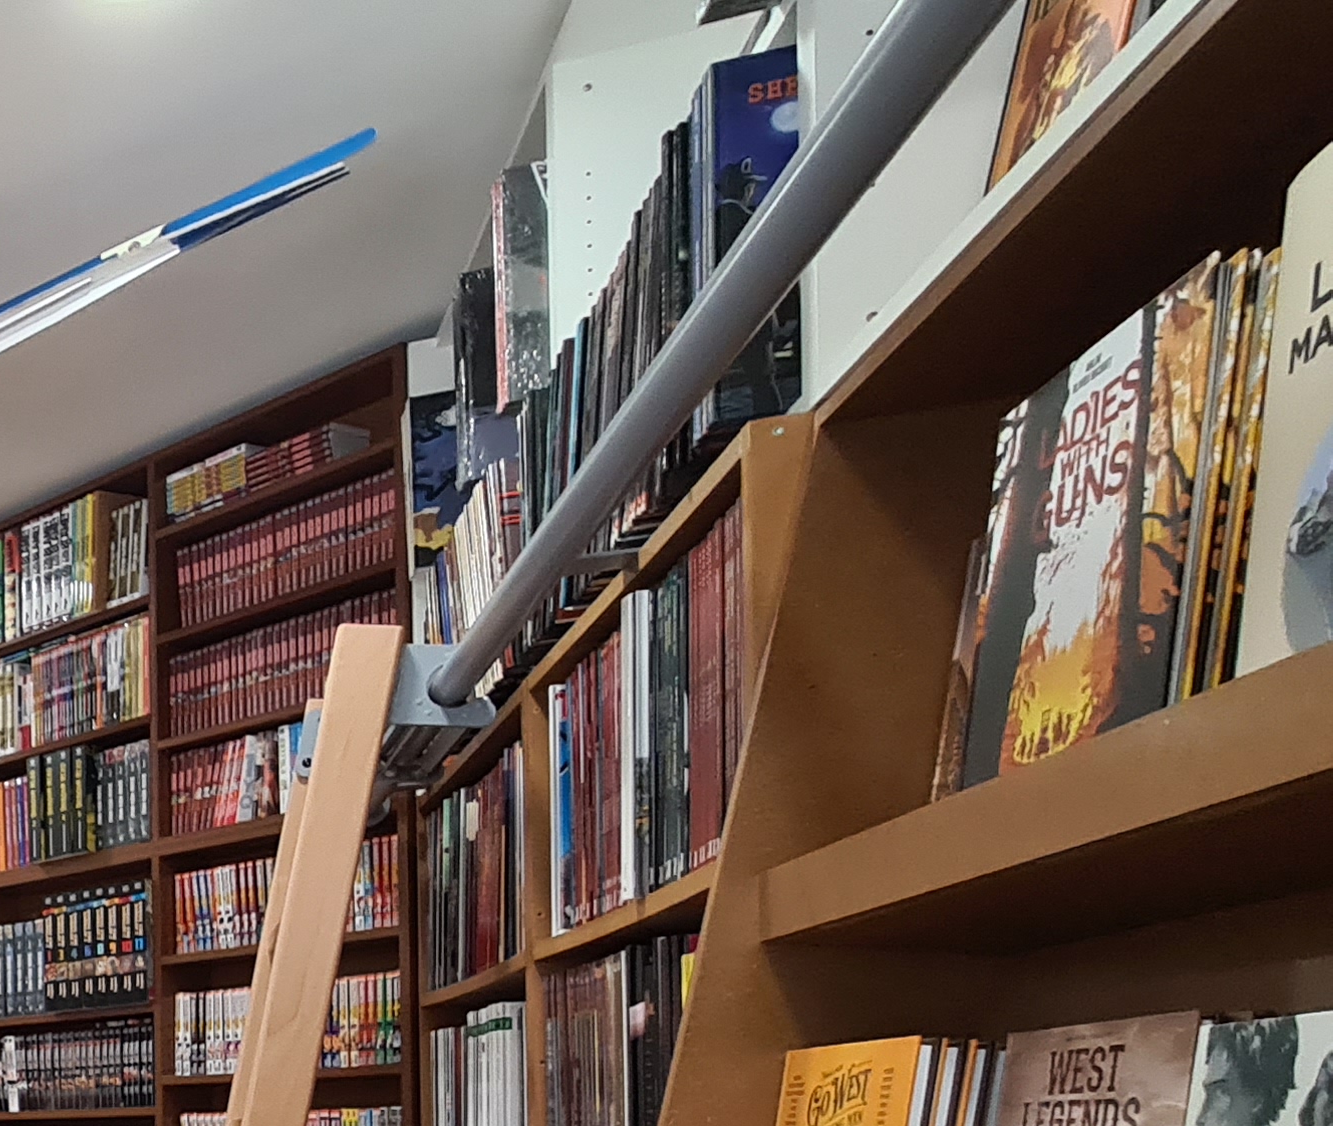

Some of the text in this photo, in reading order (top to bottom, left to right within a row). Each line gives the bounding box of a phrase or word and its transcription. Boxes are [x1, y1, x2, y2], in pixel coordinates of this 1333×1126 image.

[1037, 359, 1142, 470] LADIES
[1034, 439, 1135, 544] GUNS
[830, 1068, 872, 1111] WEST
[1047, 1044, 1127, 1096] WEST
